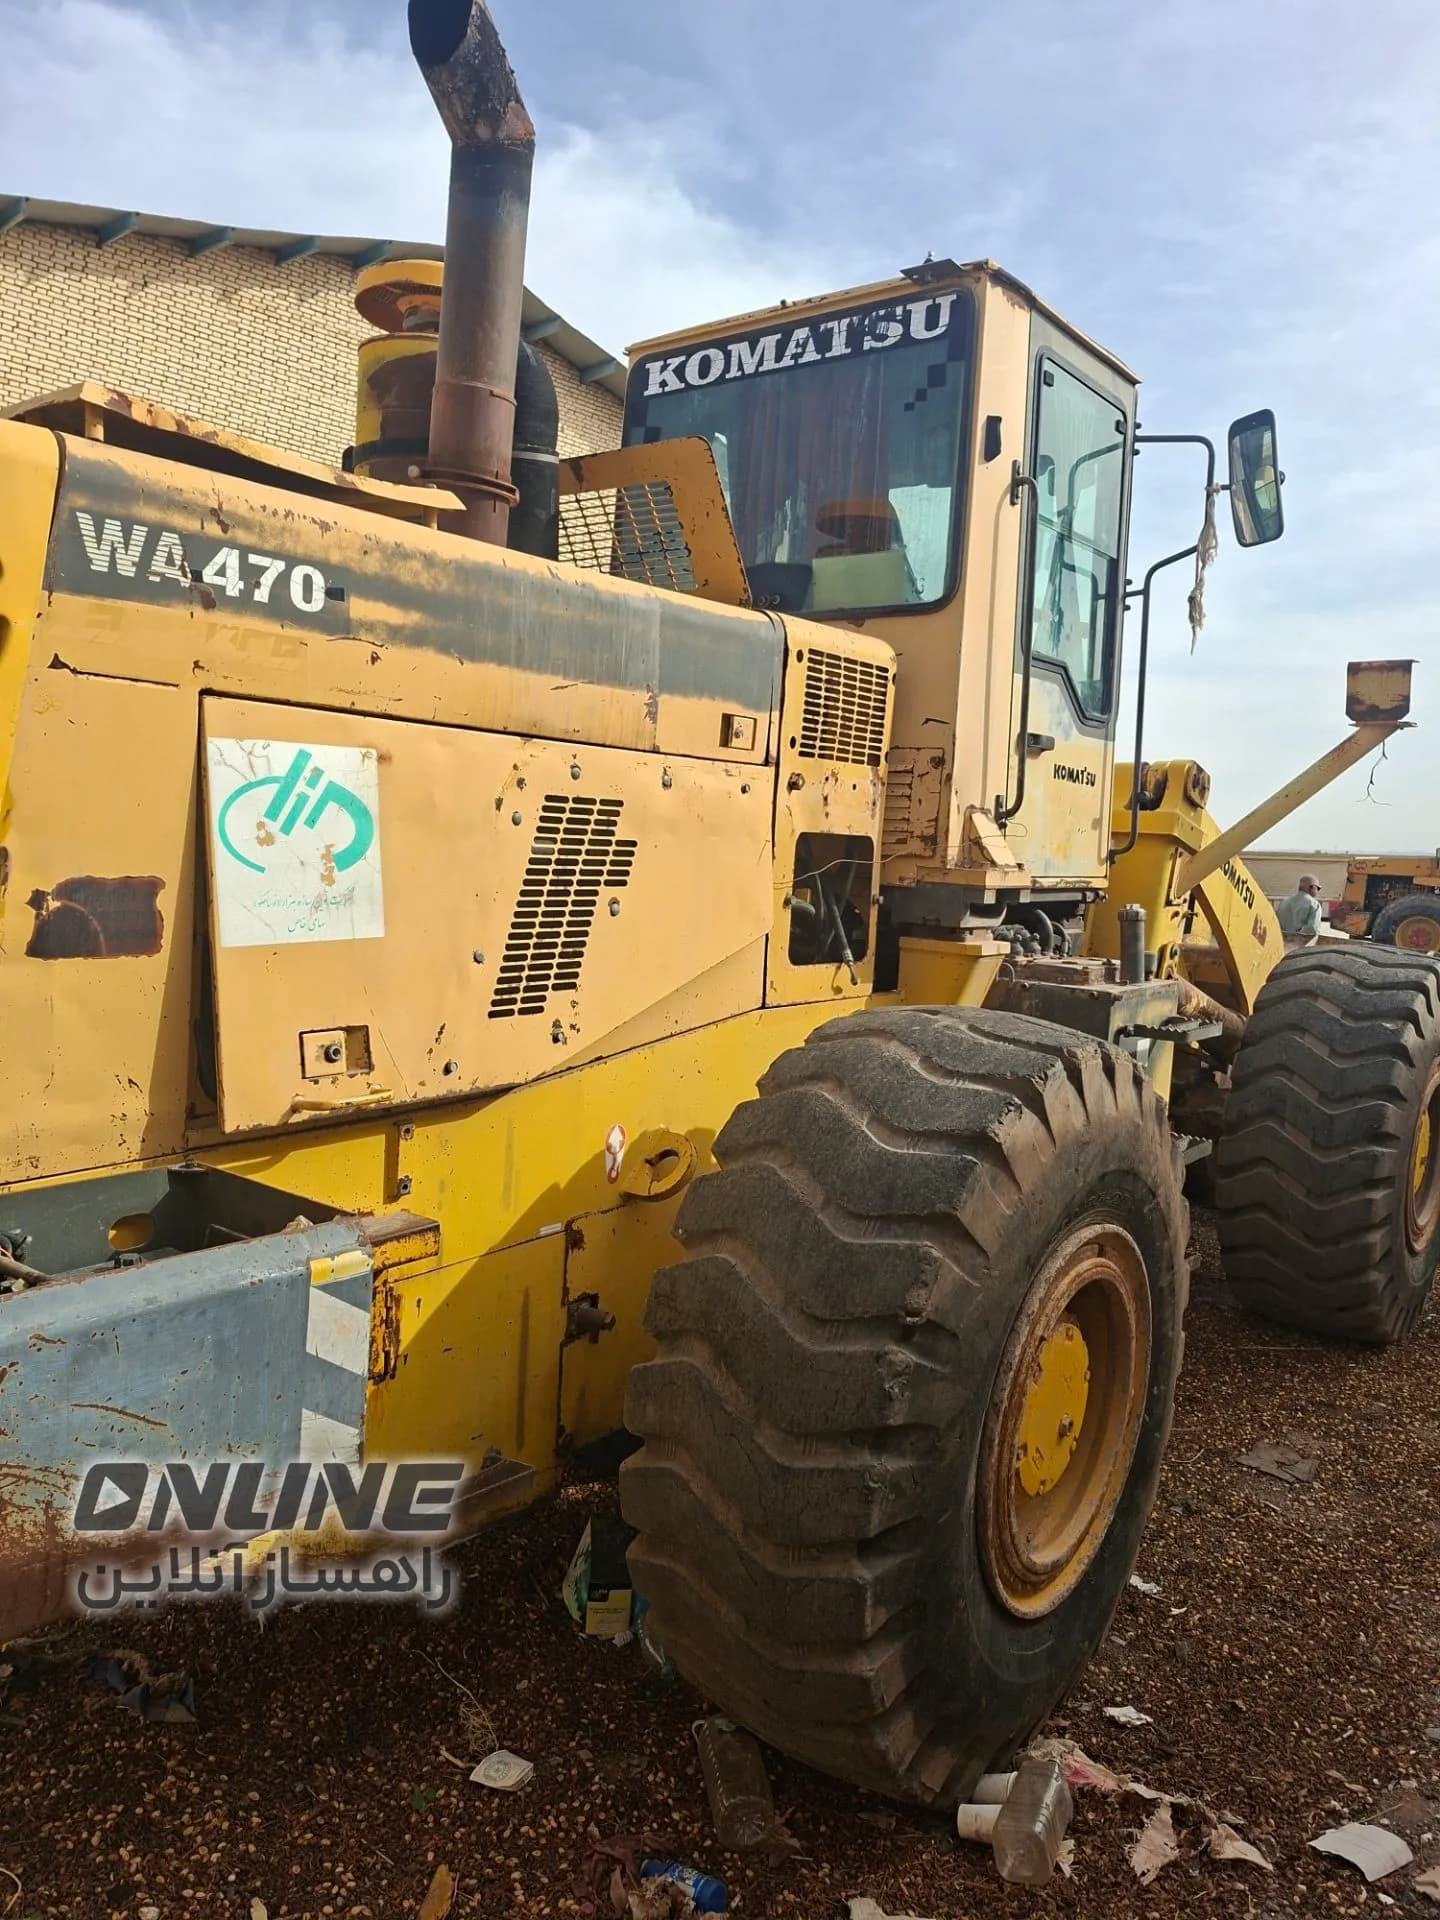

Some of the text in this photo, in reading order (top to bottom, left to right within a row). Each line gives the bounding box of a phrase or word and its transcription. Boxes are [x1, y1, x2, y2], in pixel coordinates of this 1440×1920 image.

[643, 294, 957, 396] KOMATSU
[76, 511, 326, 613] WA 470
[1053, 763, 1096, 787] KOMATSU
[1220, 859, 1255, 910] OMATSU
